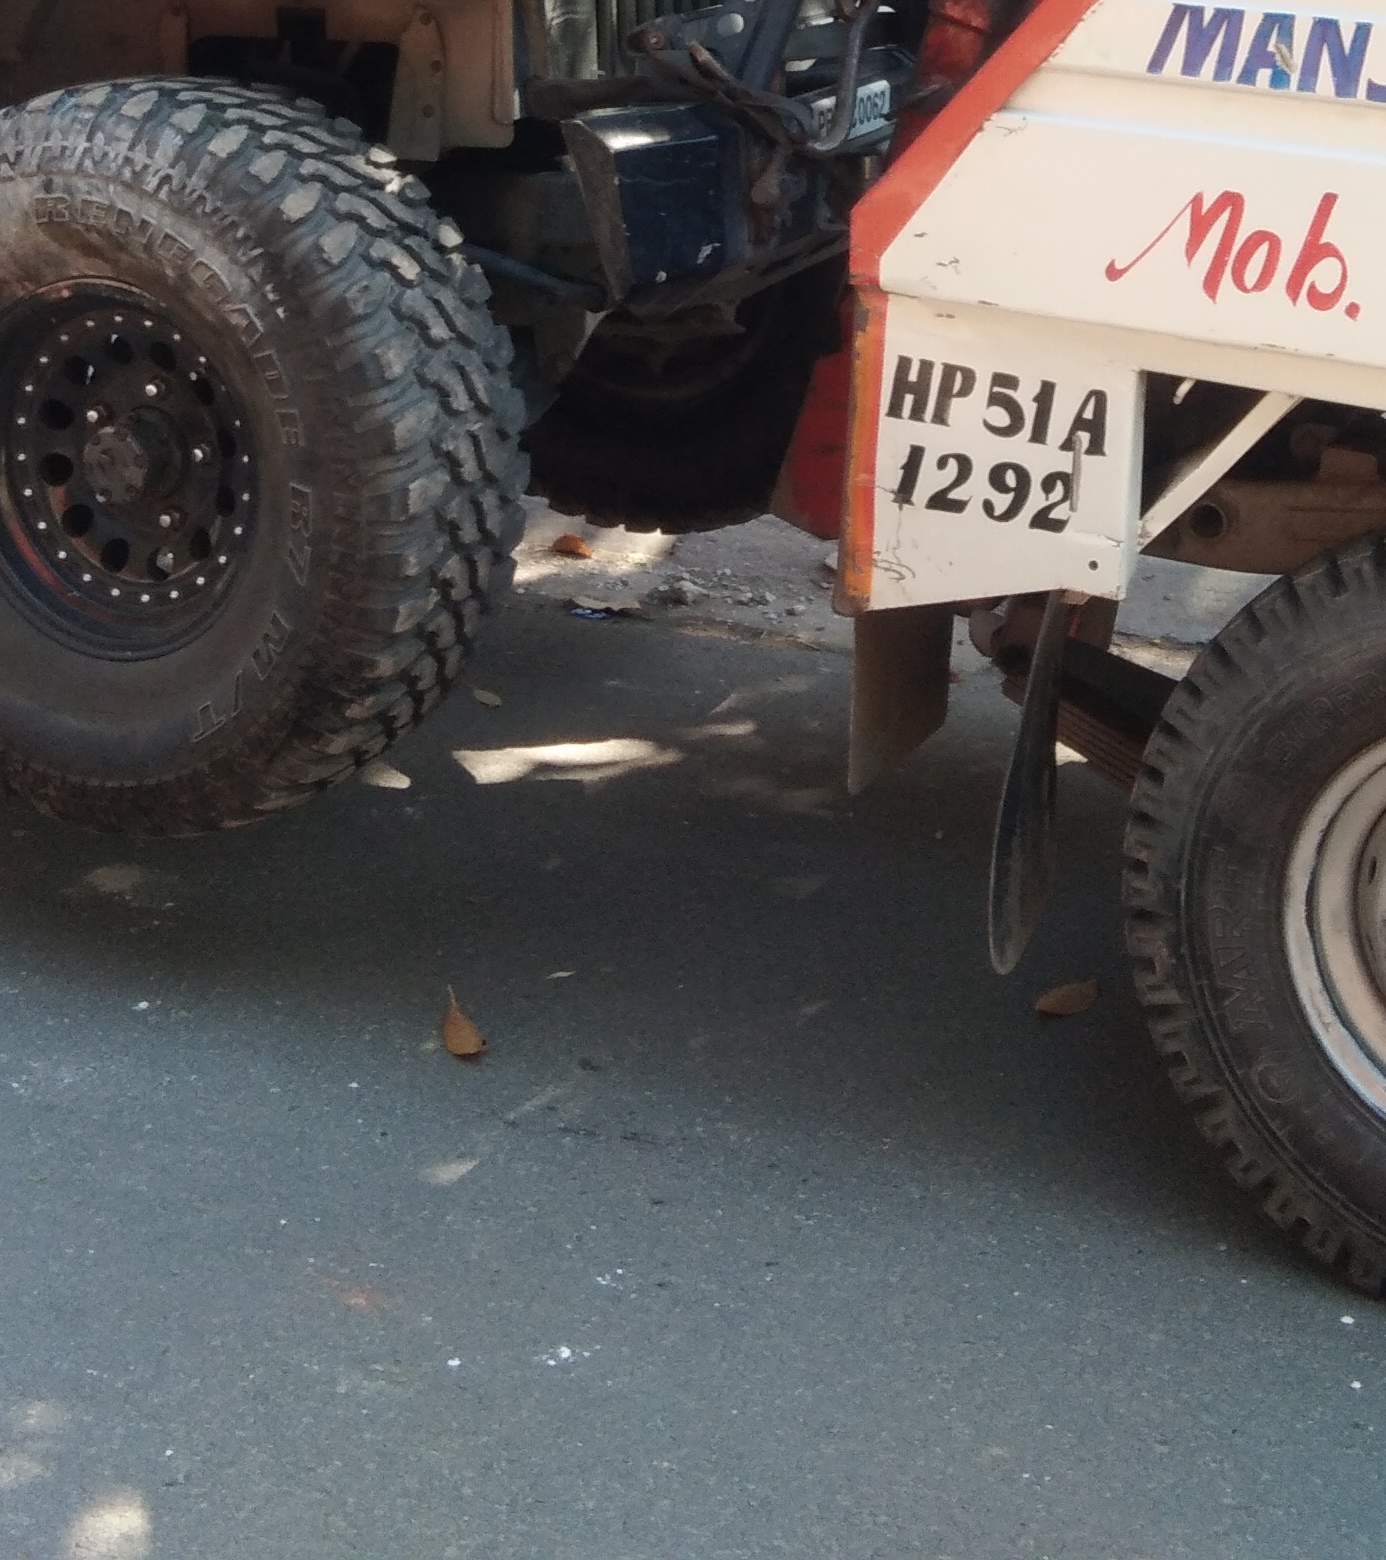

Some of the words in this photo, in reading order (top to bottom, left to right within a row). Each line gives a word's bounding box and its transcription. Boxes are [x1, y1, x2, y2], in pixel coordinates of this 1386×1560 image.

[852, 89, 889, 130] 0062
[1104, 189, 1362, 322] Mob.
[33, 194, 308, 447] RENEGADE
[890, 443, 1074, 534] 1292
